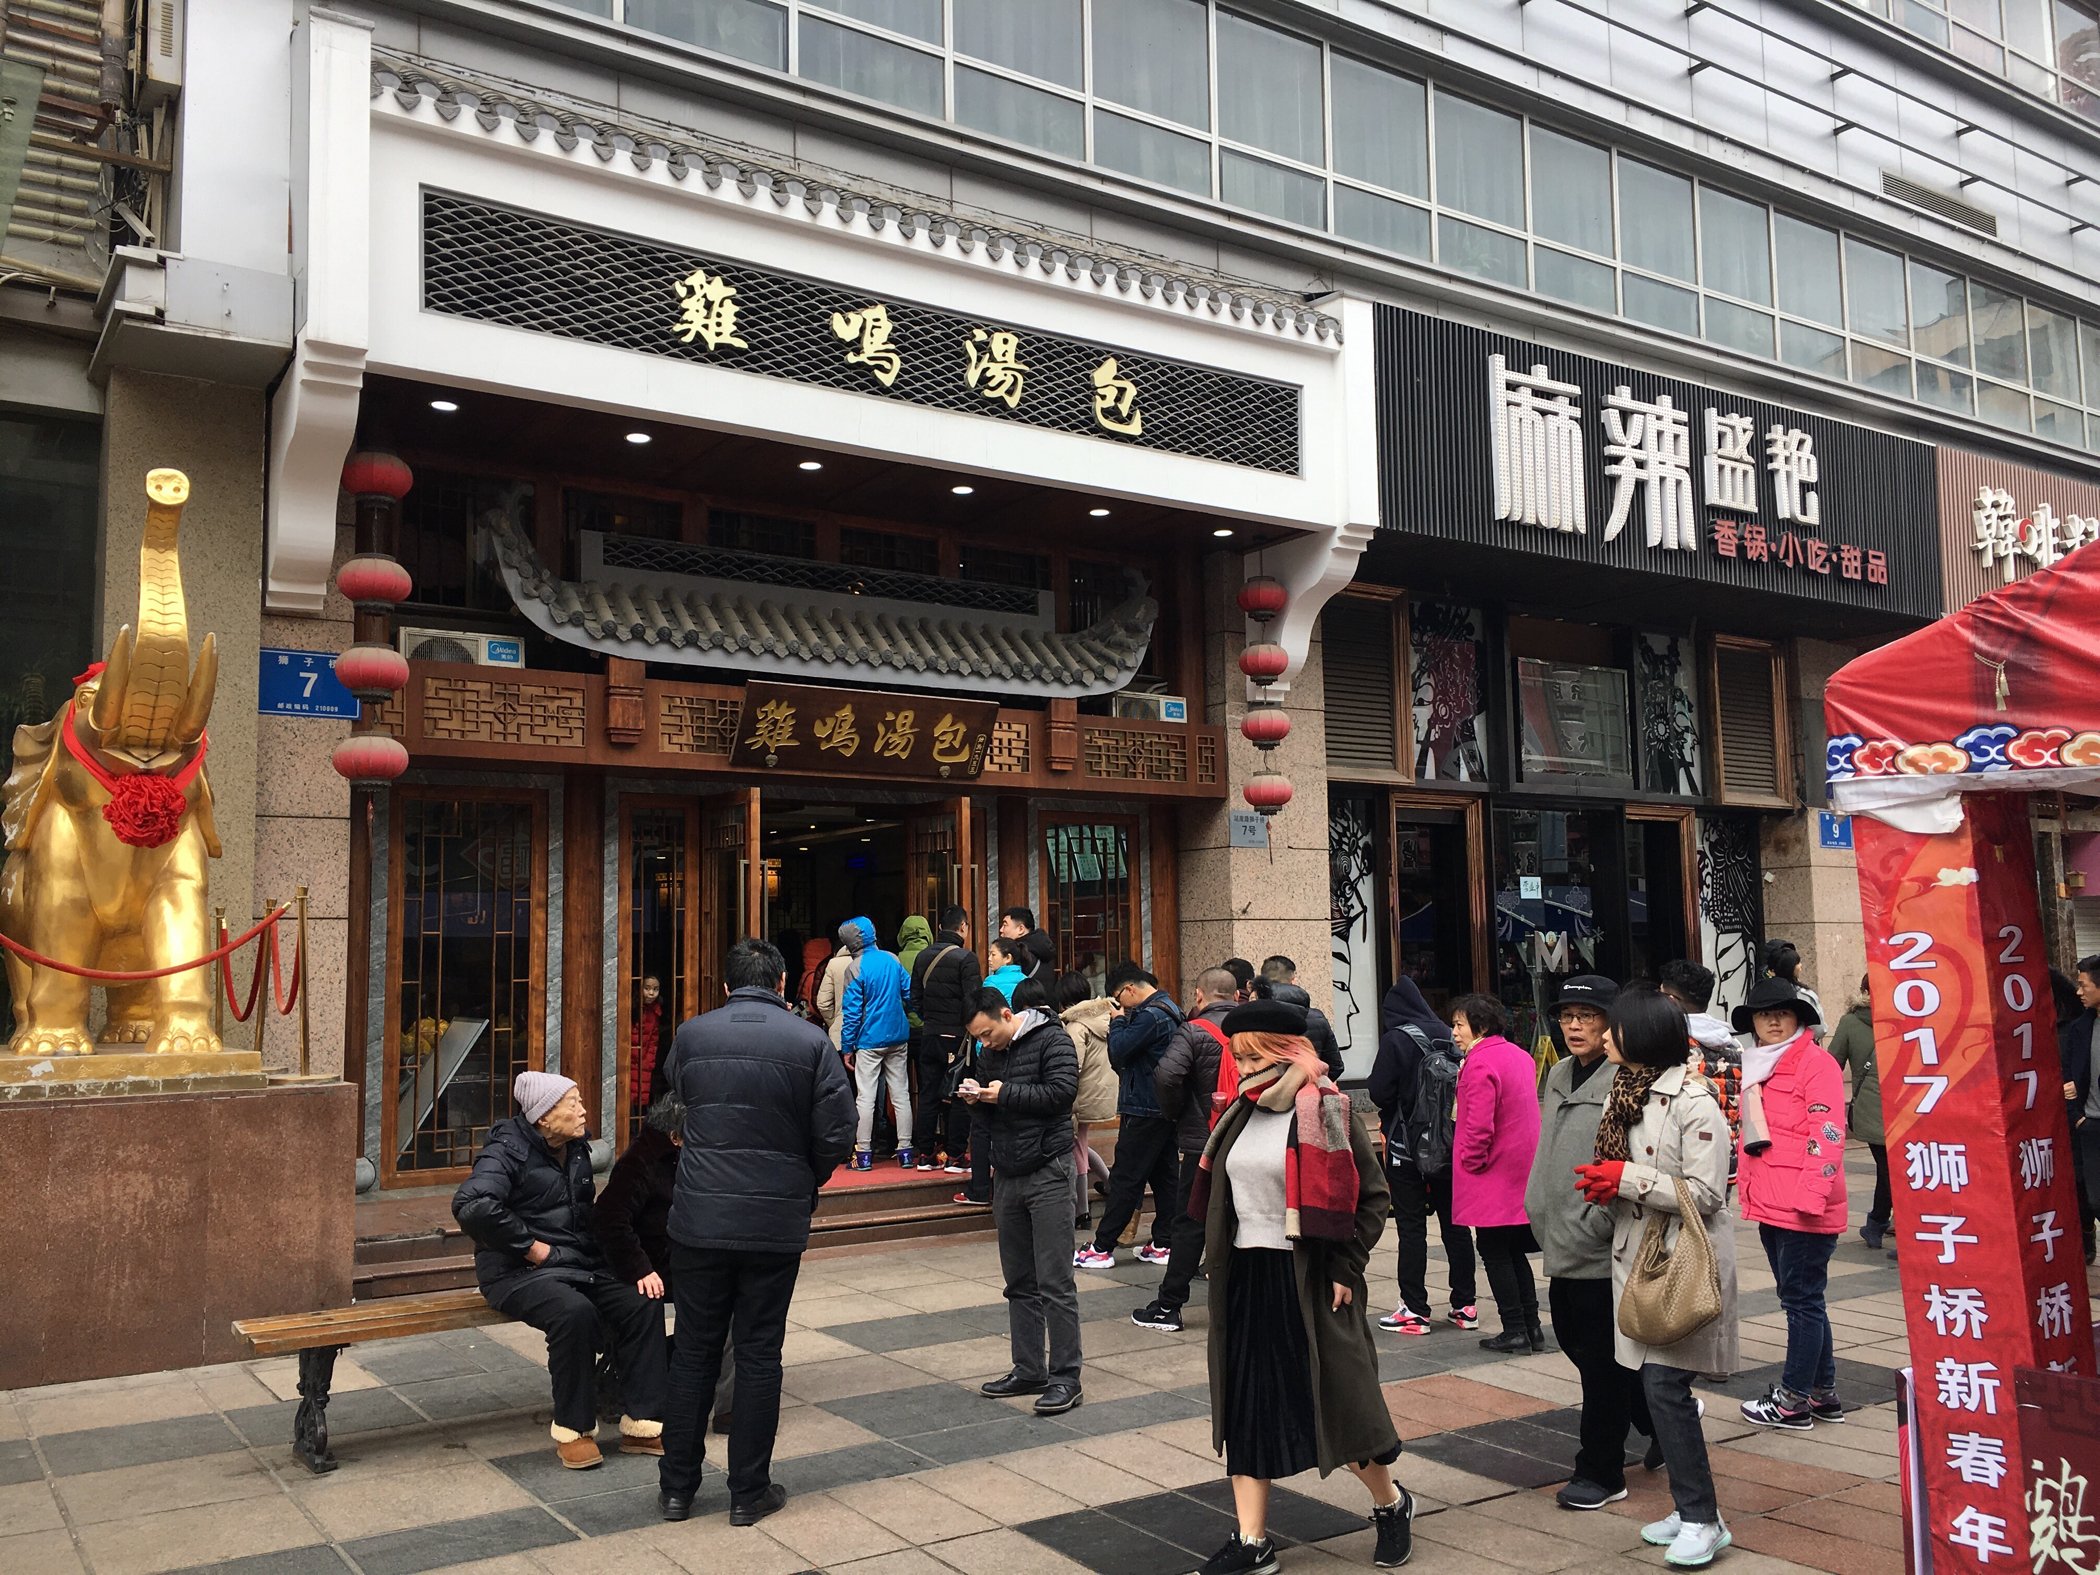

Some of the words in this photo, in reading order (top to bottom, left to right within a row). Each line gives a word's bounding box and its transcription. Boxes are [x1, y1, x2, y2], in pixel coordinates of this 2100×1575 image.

[1488, 353, 1820, 552] 麻辣盛艳
[299, 671, 318, 698] 7
[744, 698, 970, 764] 雞鳴湯包
[1241, 825, 1257, 836] 7号
[1832, 823, 1840, 839] 9
